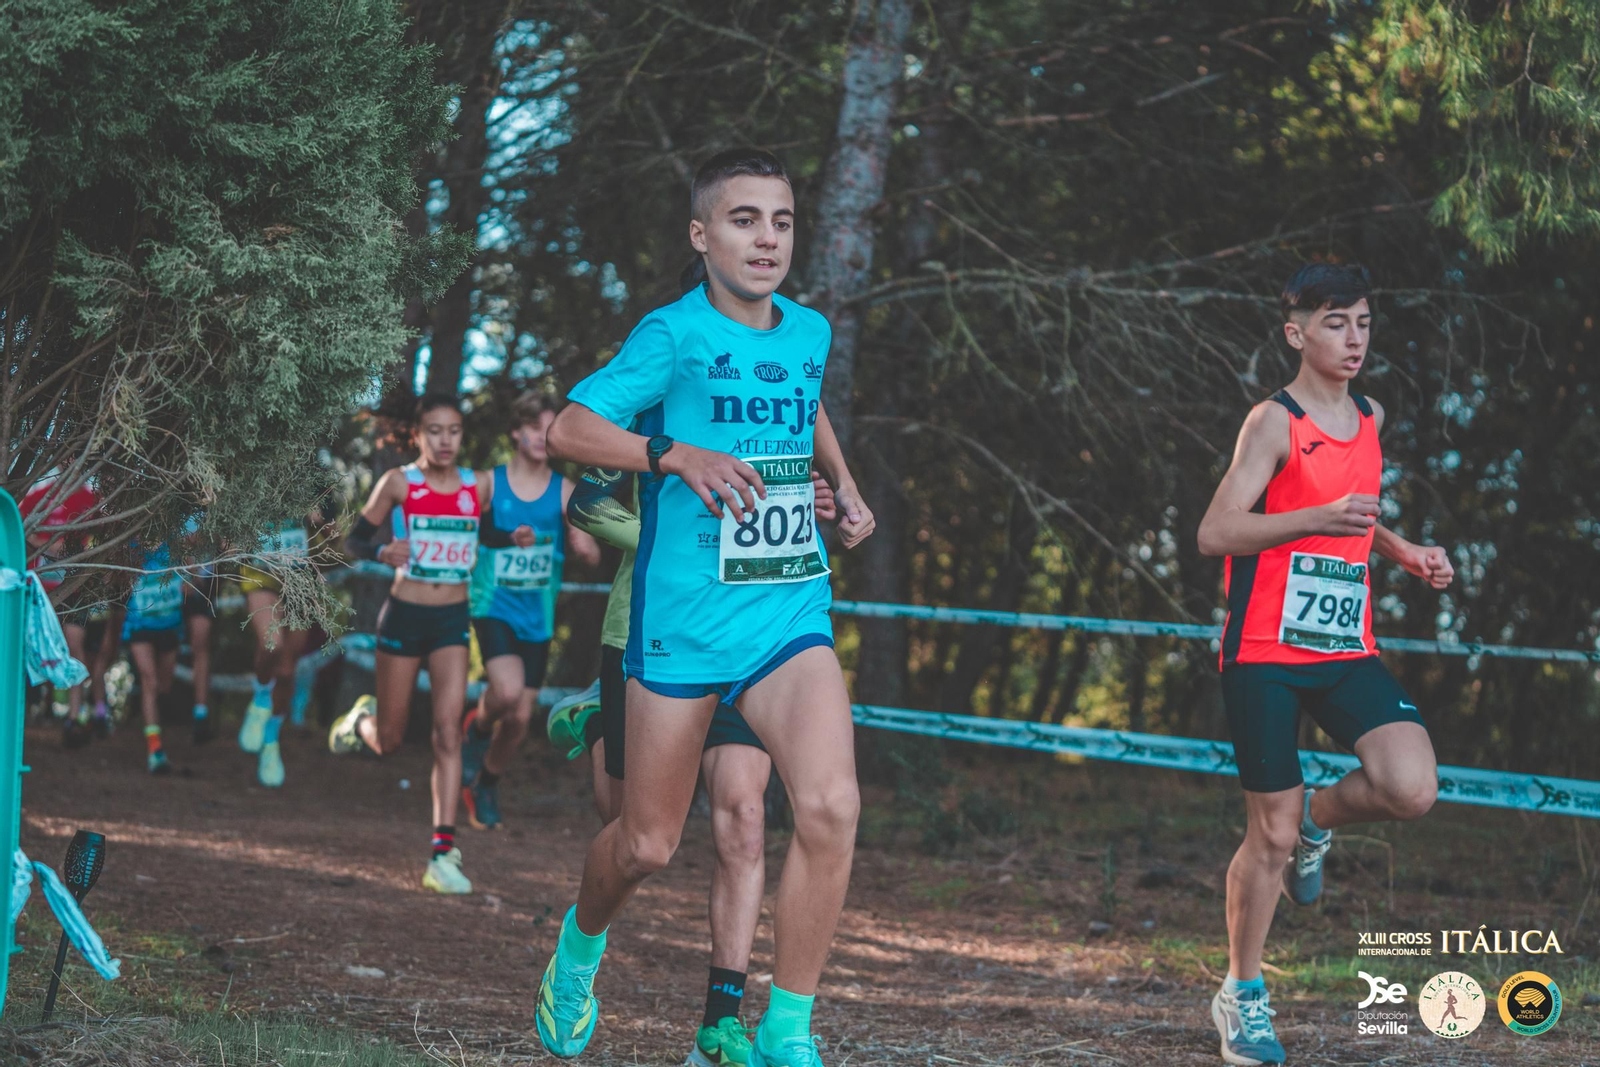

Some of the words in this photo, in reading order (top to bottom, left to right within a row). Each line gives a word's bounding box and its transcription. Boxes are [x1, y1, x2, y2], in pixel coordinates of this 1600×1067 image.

[708, 365, 740, 376] CUEVA
[755, 365, 788, 381] TROPS
[710, 387, 819, 435] nerja
[730, 439, 810, 455] ATLETISMO
[763, 460, 809, 477] ITÁLICA
[734, 502, 812, 548] 8023
[416, 541, 472, 565] 7266
[501, 553, 551, 574] 7962
[1297, 590, 1362, 628] 7984
[712, 981, 744, 998] FILA
